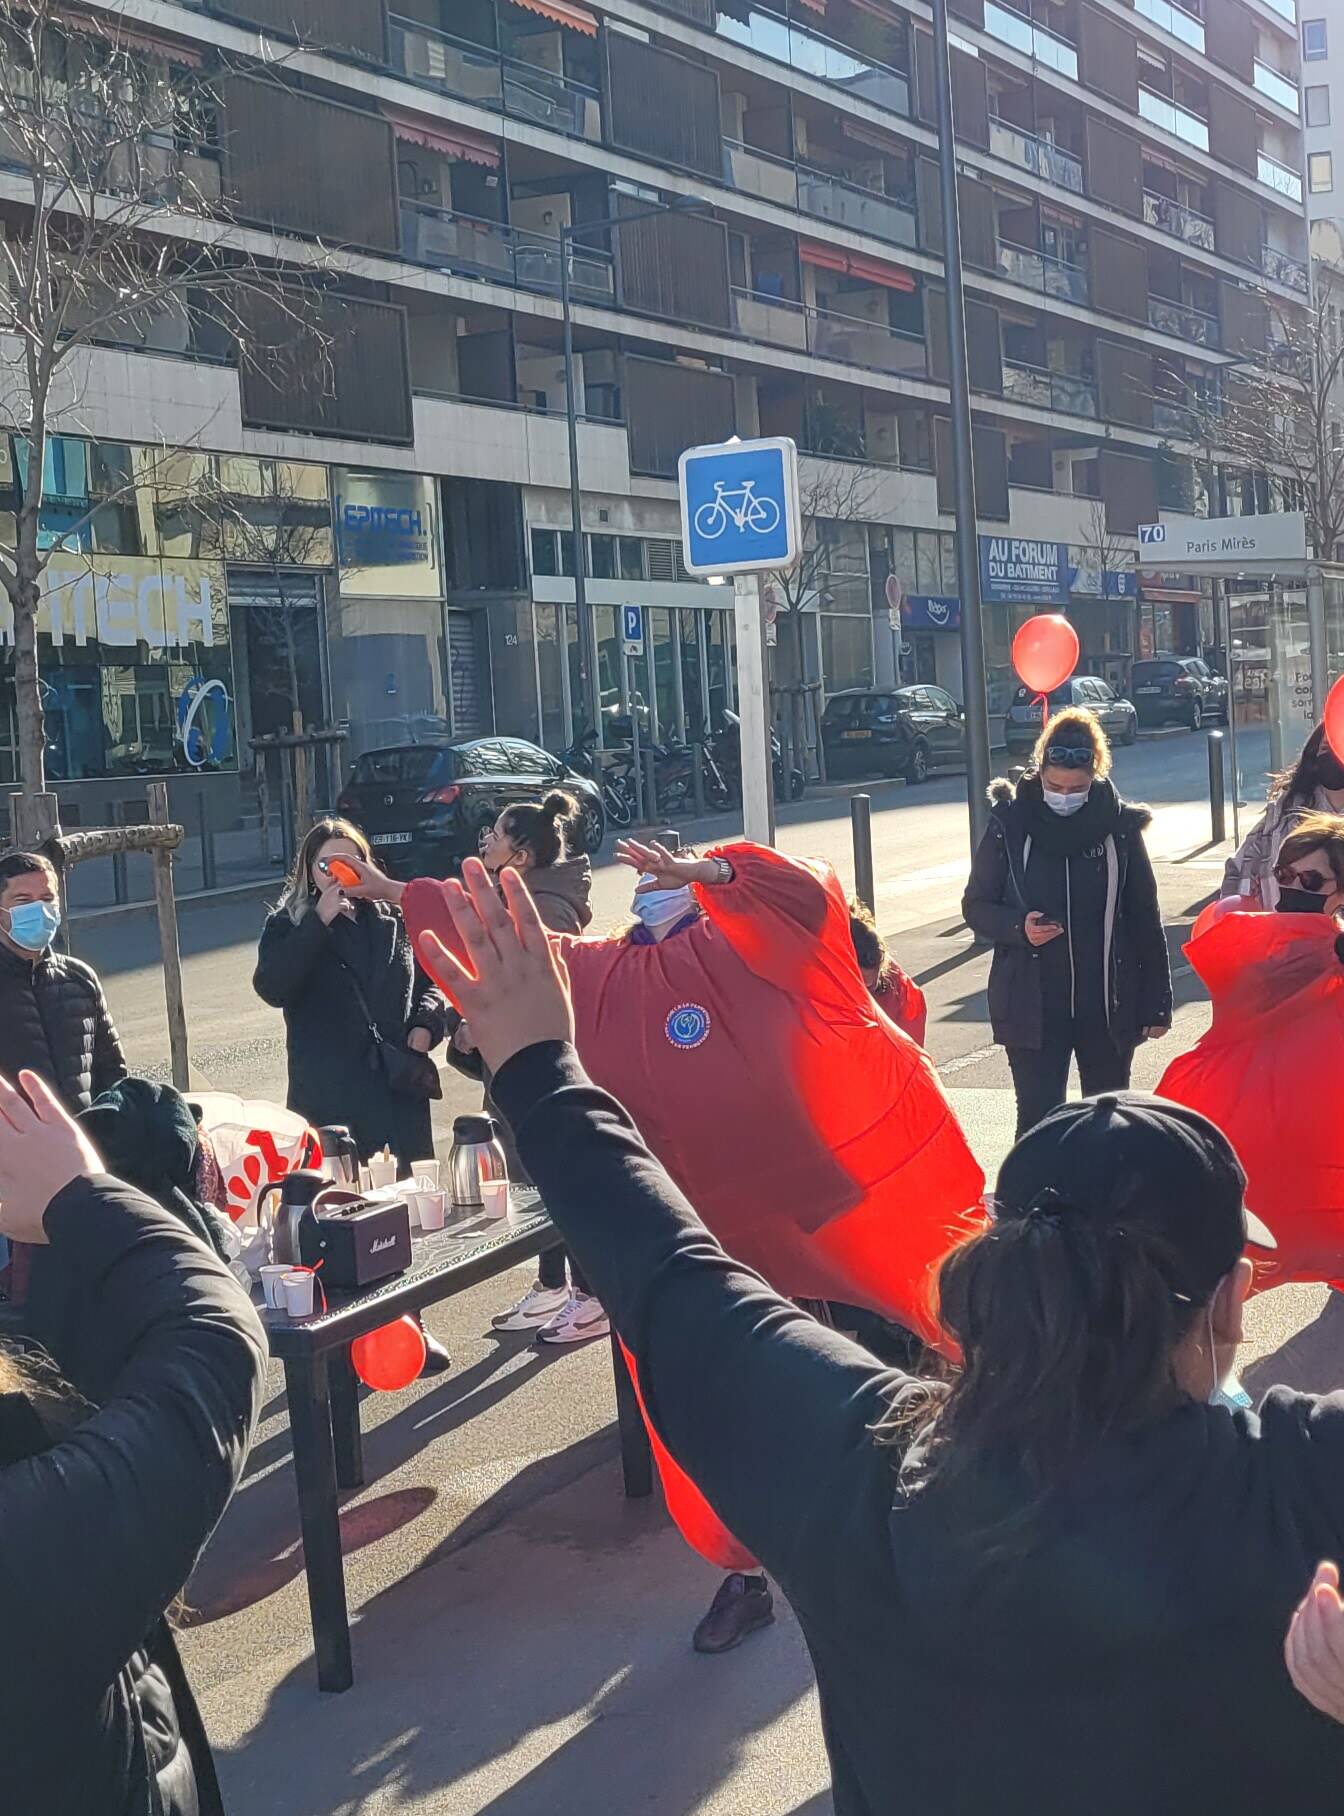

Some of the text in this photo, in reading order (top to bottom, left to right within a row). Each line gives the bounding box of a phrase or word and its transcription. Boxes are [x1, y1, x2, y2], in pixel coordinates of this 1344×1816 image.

[1141, 526, 1164, 543] 70
[989, 539, 1058, 565] AU FORUM
[1186, 536, 1256, 553] Paris Mirès
[989, 562, 1058, 580] DU BATIMENT
[628, 611, 637, 635] P
[505, 634, 518, 646] 124
